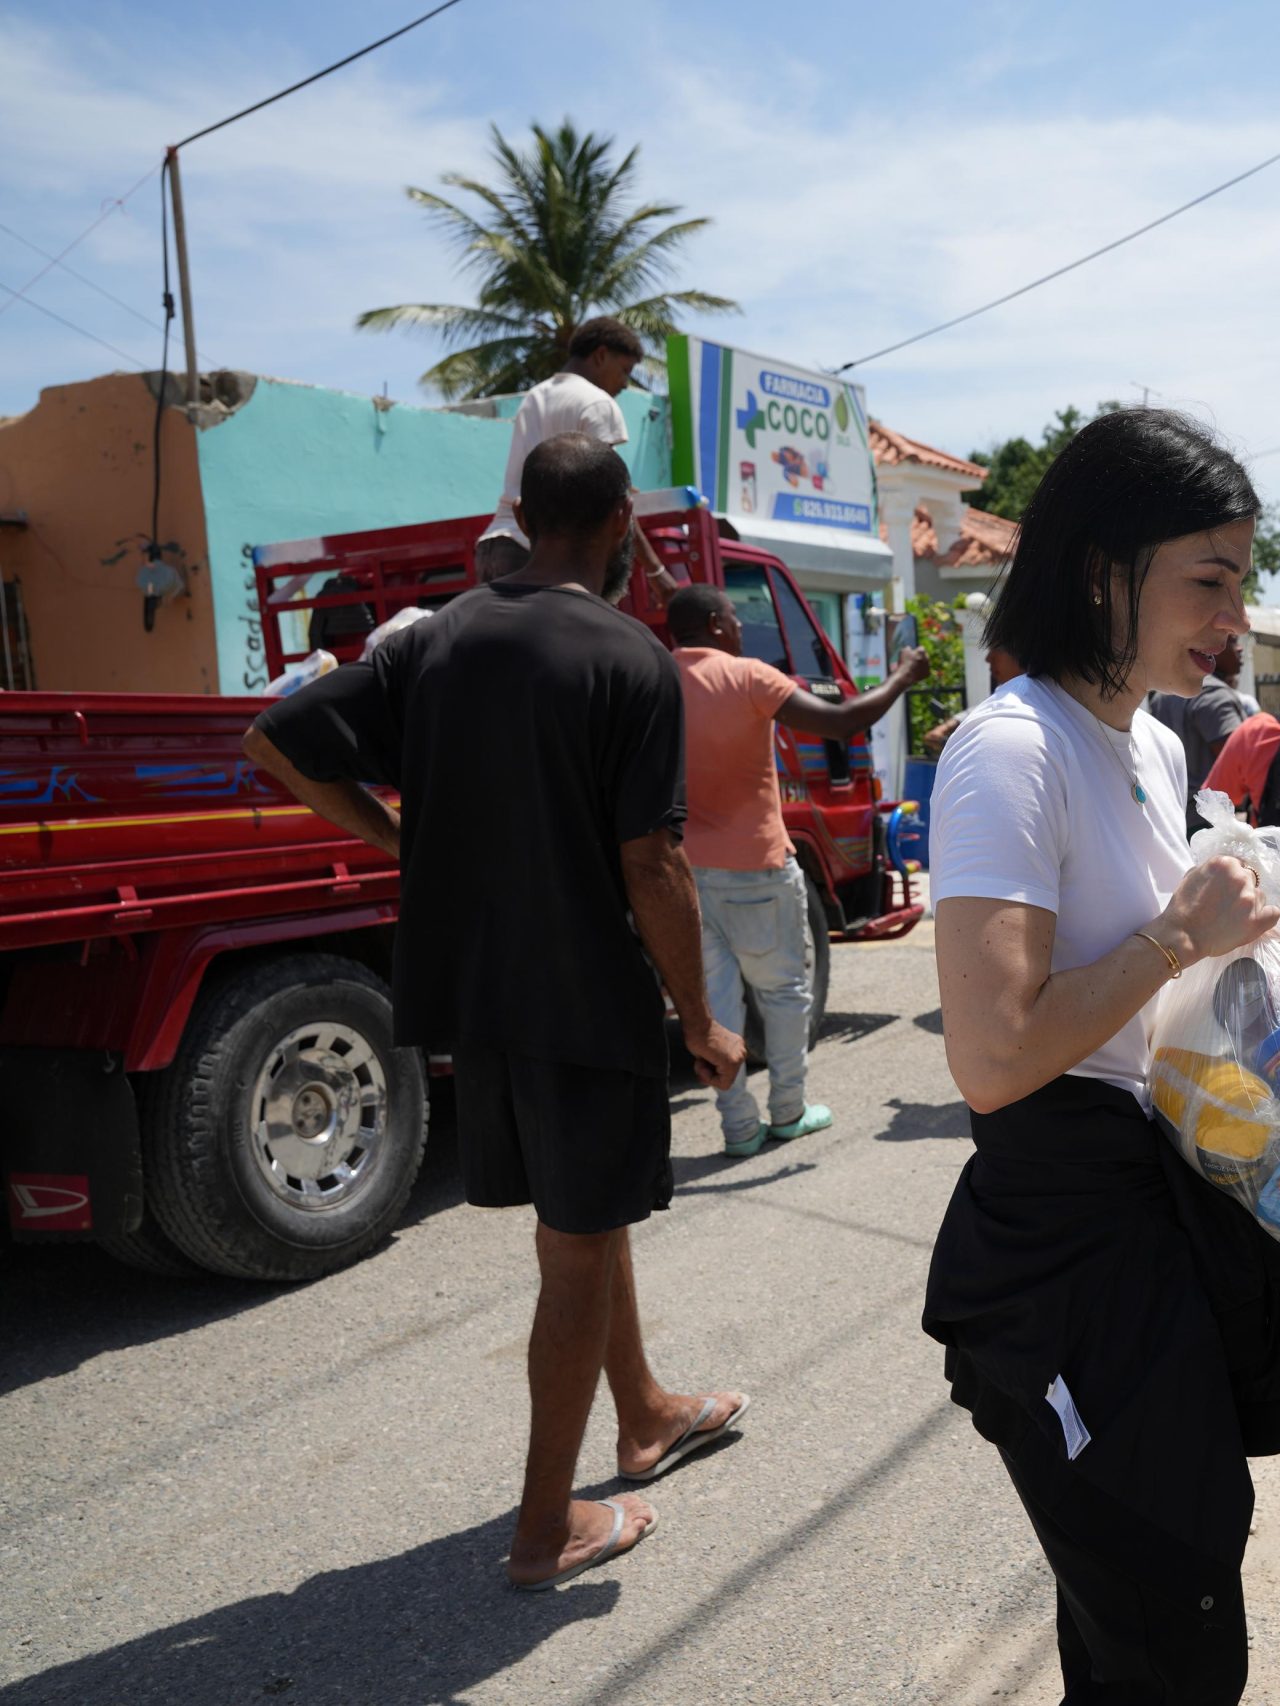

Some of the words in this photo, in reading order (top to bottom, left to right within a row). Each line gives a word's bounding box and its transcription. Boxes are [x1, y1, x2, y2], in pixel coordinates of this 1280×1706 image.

[765, 375, 824, 405] FARMACIA
[768, 400, 829, 440] COCO
[811, 683, 840, 695] DELTA
